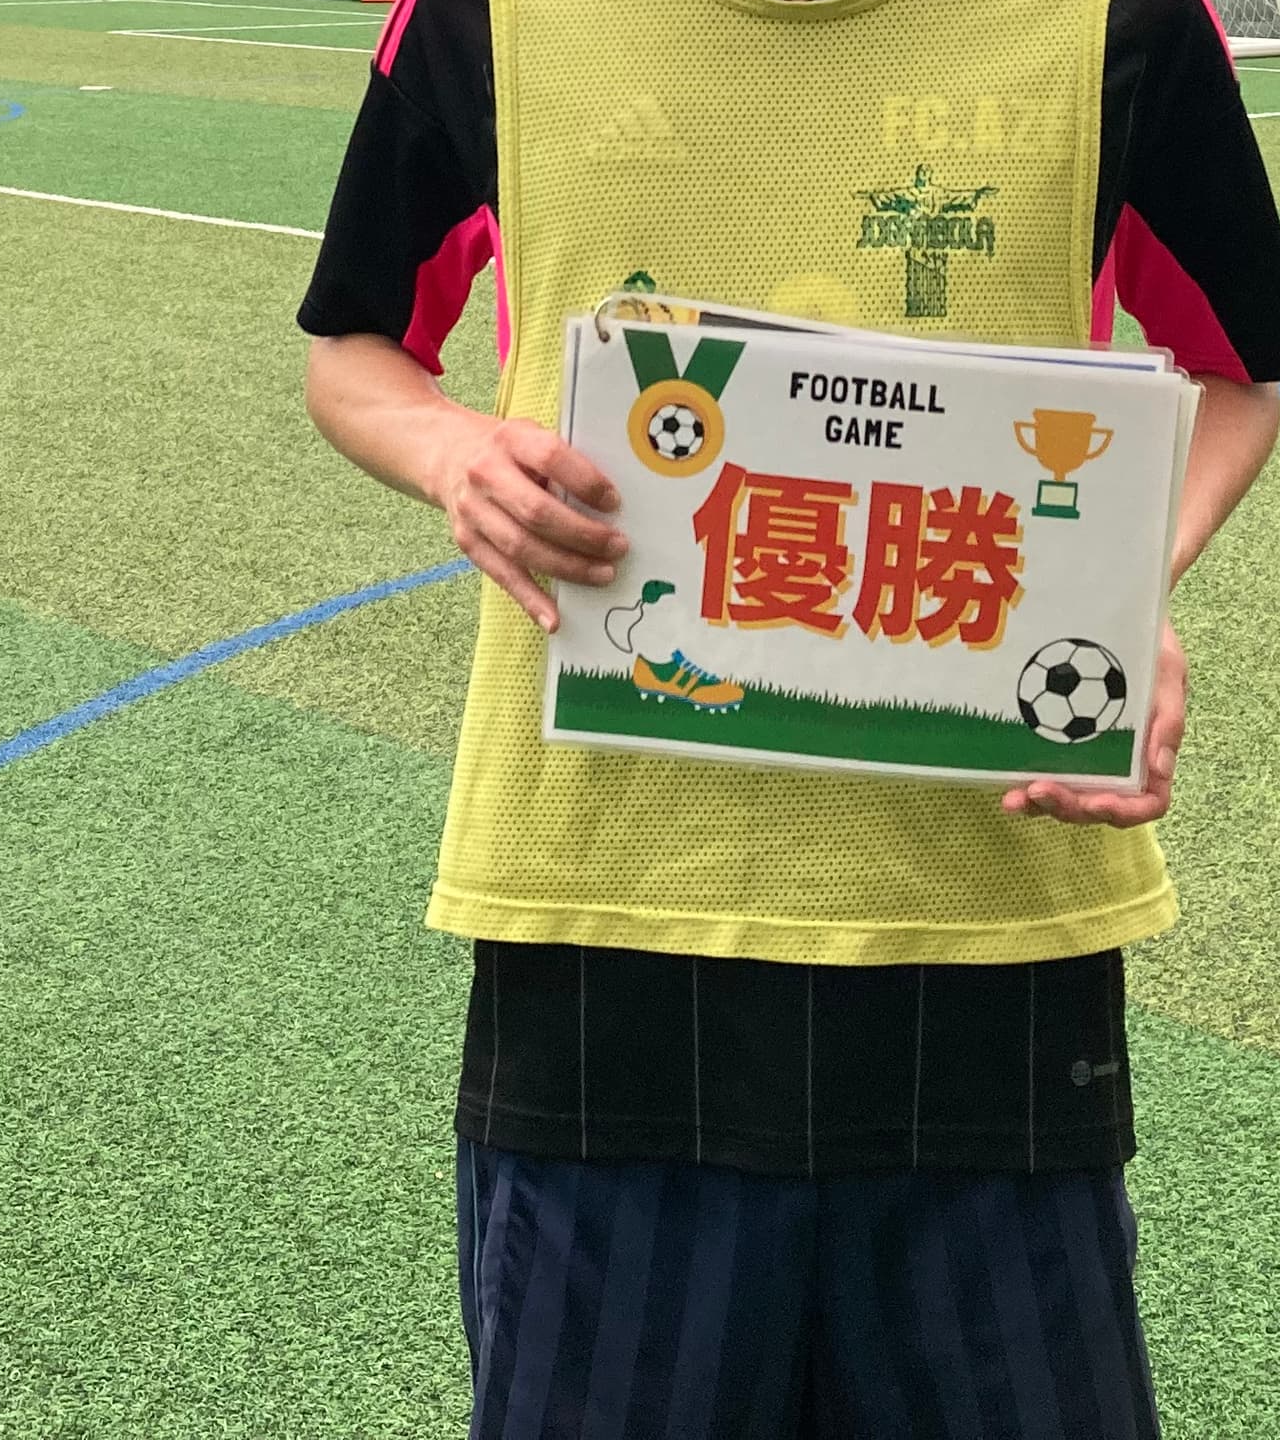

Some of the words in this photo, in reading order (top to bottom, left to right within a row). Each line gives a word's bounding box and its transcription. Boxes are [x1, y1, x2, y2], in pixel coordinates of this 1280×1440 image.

[790, 372, 945, 414] FOOTBALL
[825, 415, 904, 449] GAME
[692, 462, 1023, 649] 優勝
